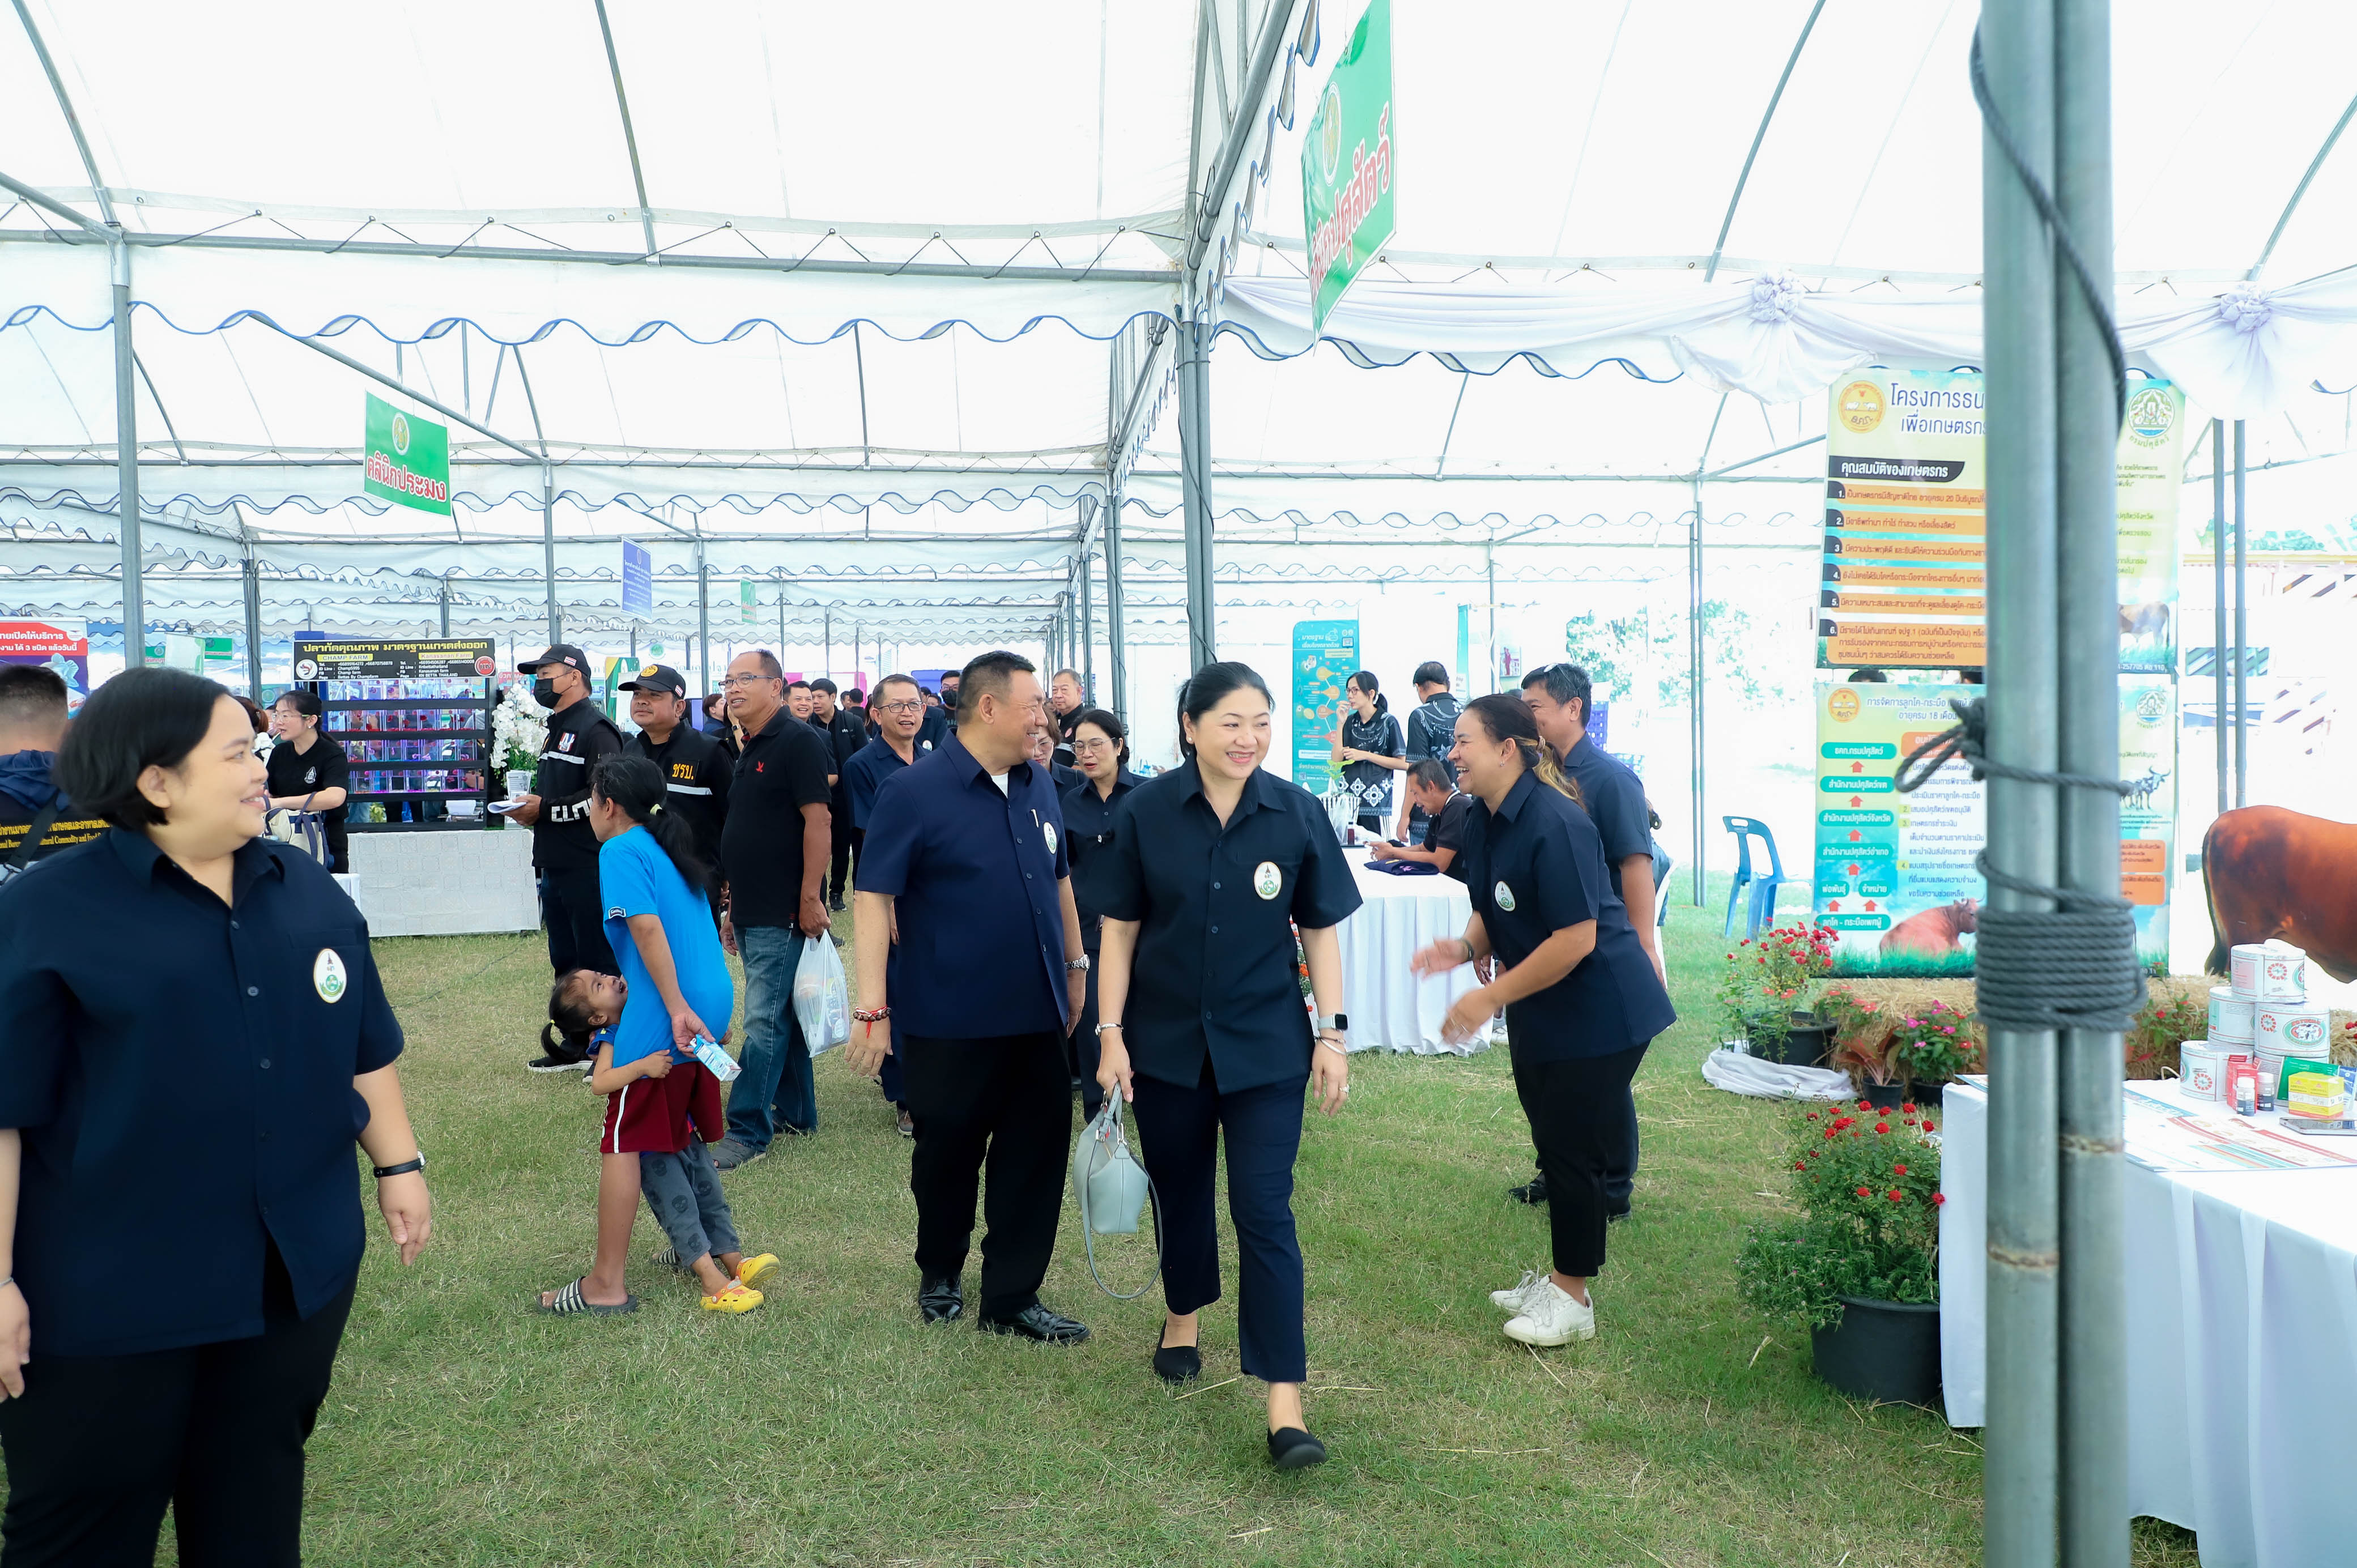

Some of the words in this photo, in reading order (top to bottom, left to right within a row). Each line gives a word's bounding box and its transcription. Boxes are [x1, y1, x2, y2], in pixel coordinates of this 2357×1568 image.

[1891, 383, 1985, 409] โครงการธน
[1841, 462, 1948, 478] คุณสมบัติของเกษตรกร
[367, 451, 446, 502] คลินิกประมง
[1838, 490, 1845, 498] 1.
[1847, 489, 1918, 502] เป็นเกษตรกรมีสัญชาติไทย
[1956, 493, 1985, 505] ปีบริบูรณ์
[1895, 544, 1985, 556] และยินดีให้ความร่วมมือกับทางรา
[1967, 573, 1985, 583] มาก่อ
[1830, 627, 1837, 635] 6.
[48, 642, 78, 651] แล้ววันนี้
[303, 642, 380, 654] ปลากัดคุณภาพ
[383, 641, 488, 653] มาตรฐานเกรดส่งออก
[1867, 697, 1946, 709] การจัดการลูกโค-กระบือ
[1899, 711, 1926, 722] อายุครบ
[671, 763, 694, 780] ชรบ.
[1828, 779, 1888, 791] สำนักงานปศุสัตว์เขต
[1823, 812, 1891, 825] สำนักงานปศุสัตว์จังหวัด
[1822, 846, 1890, 858] สำนักงานปศุสัตว์อำเภอ
[1822, 883, 1847, 895] พ่อพันธุ์
[1862, 883, 1887, 893] จำหน่าย
